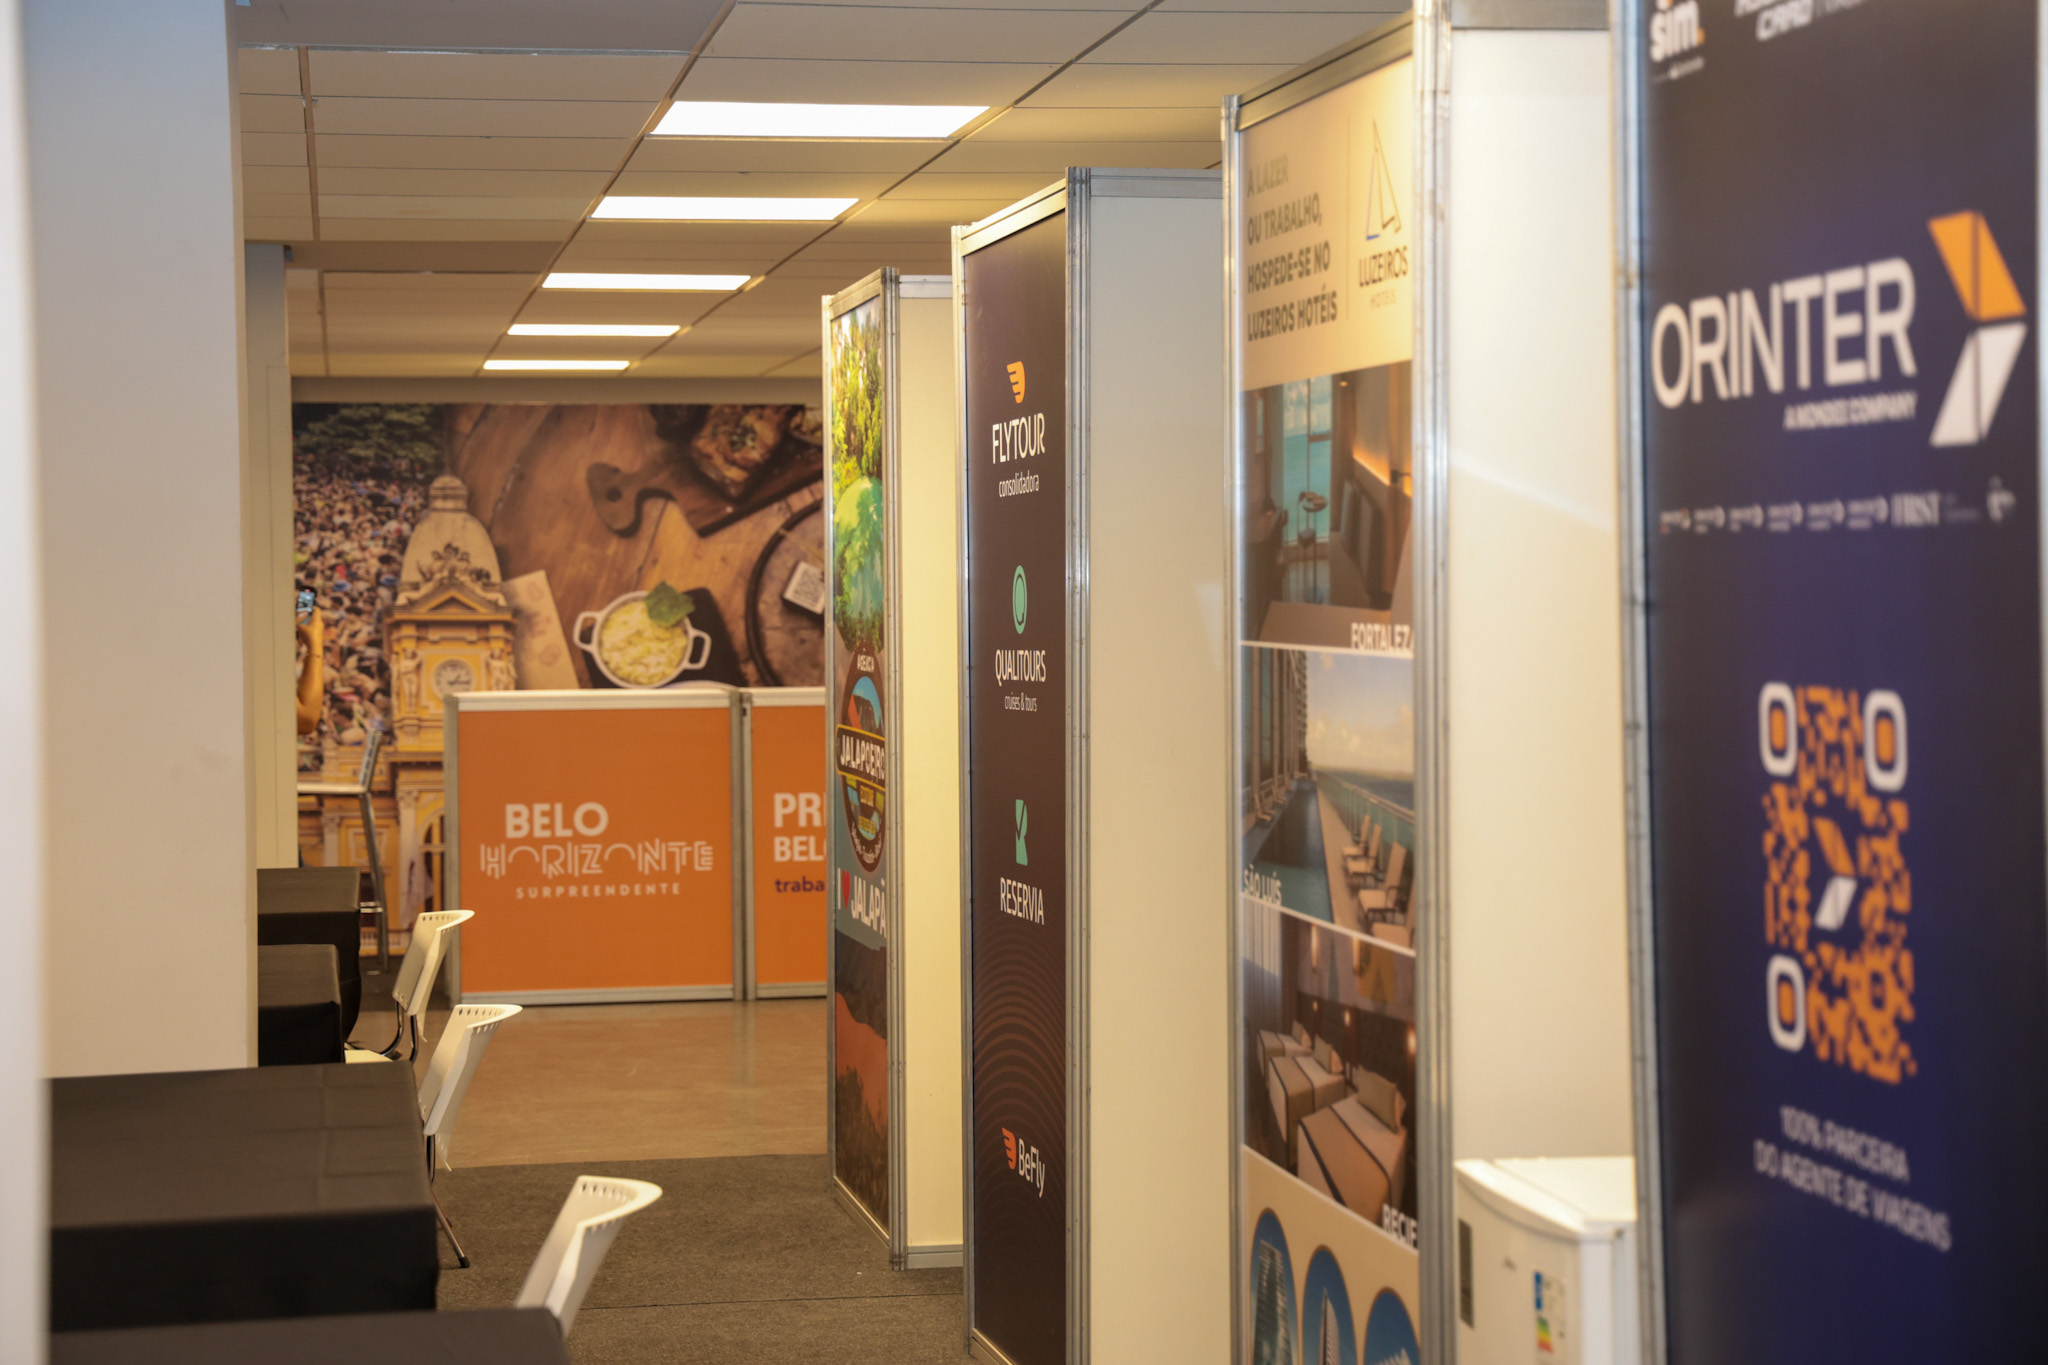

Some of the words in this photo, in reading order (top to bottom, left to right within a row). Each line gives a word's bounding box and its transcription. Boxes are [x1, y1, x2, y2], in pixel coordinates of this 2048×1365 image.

[1256, 154, 1289, 193] LAZER
[1248, 216, 1262, 245] OU
[1264, 192, 1322, 240] TRABALHO,
[1248, 247, 1311, 293] HOSPEDE-SE
[1314, 240, 1331, 274] NO
[1359, 246, 1408, 288] LUZEIROS
[1248, 302, 1295, 342] LUZEIROS
[1298, 283, 1337, 330] HOTÉIS
[1652, 257, 1917, 408] ORINTER
[992, 412, 1045, 464] FLYTOUR
[999, 470, 1039, 497] consolidadora
[1351, 622, 1414, 652] FORTALEZ
[995, 649, 1046, 686] QUALITOURS
[1004, 692, 1020, 710] cruises
[1020, 692, 1025, 711] &
[1025, 695, 1037, 711] tours
[505, 801, 609, 838] BELO
[774, 792, 826, 828] PR
[480, 838, 713, 879] HORIZONTE
[774, 836, 826, 862] BEL
[516, 883, 681, 899] SURPREENDENTE
[1000, 877, 1044, 925] RESERVIA
[1244, 864, 1261, 898] SÃO
[1262, 871, 1282, 905] LUÍS
[1019, 1138, 1045, 1198] BeFly
[1753, 1139, 1778, 1178] DO
[1781, 1152, 1843, 1207] AGENTE
[1845, 1175, 1869, 1218] DE
